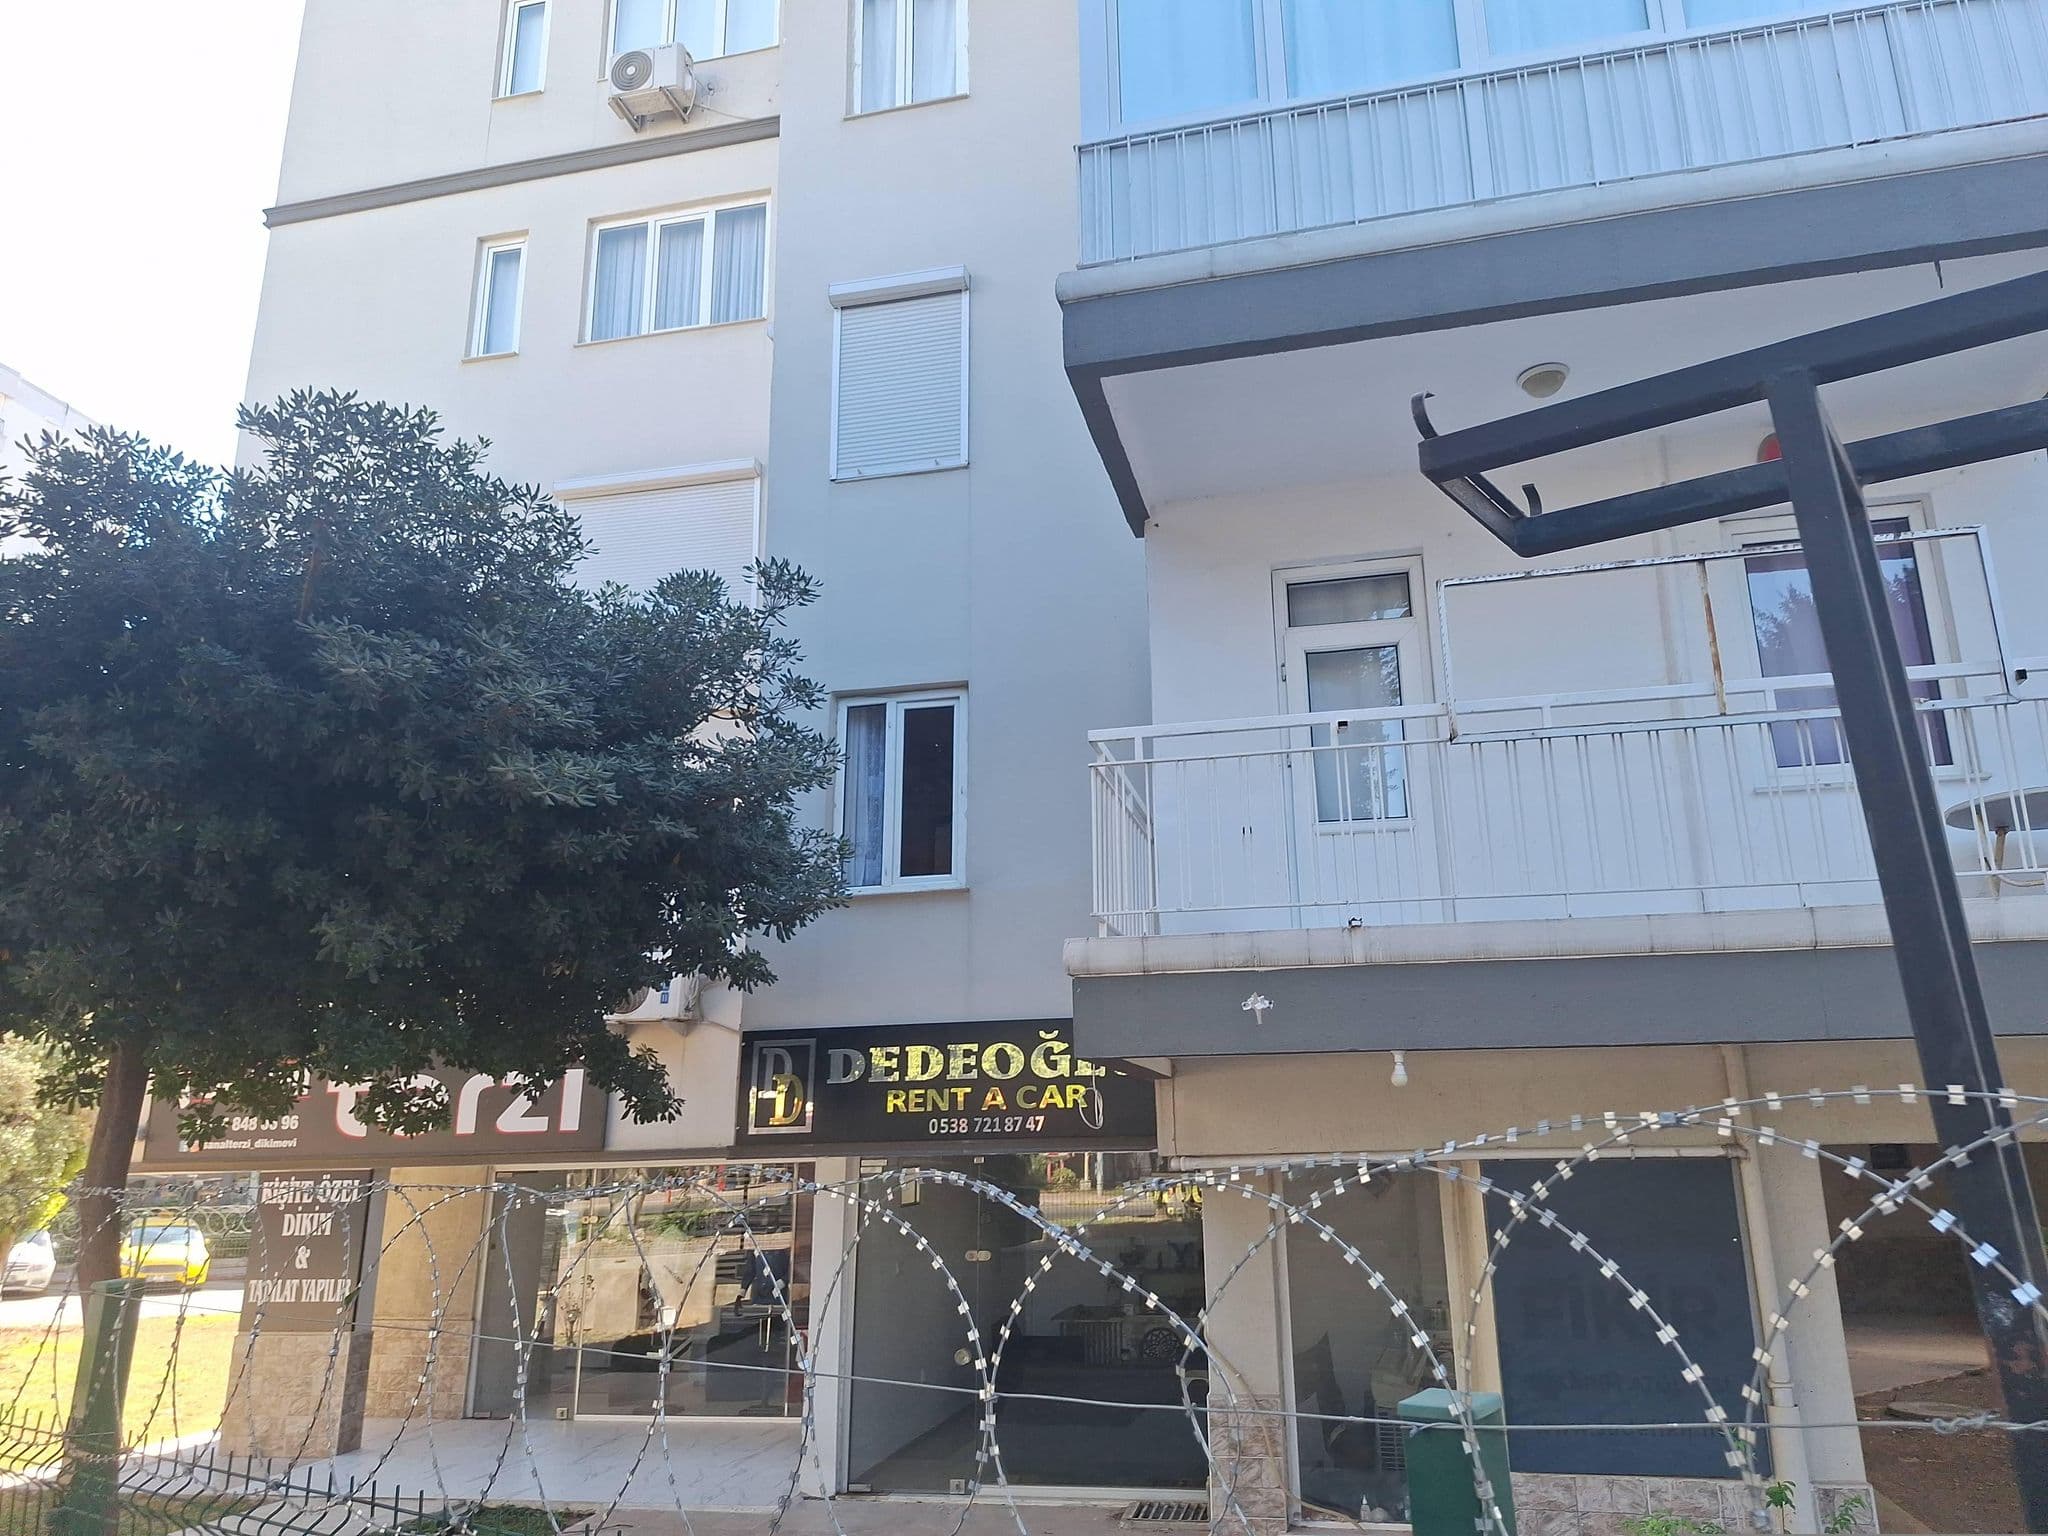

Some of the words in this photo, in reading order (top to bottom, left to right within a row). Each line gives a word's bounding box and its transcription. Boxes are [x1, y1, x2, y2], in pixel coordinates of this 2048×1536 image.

[827, 1030, 1128, 1084] DEDEOĞL
[887, 1087, 972, 1112] RENT
[981, 1087, 1007, 1111] A
[1016, 1084, 1088, 1109] CAR
[232, 1116, 258, 1131] 848
[281, 1114, 299, 1130] 96
[928, 1118, 969, 1134] 0538
[974, 1116, 1001, 1133] 721
[1025, 1115, 1045, 1132] 47
[281, 1206, 334, 1236] DİKİM
[295, 1246, 311, 1269] &
